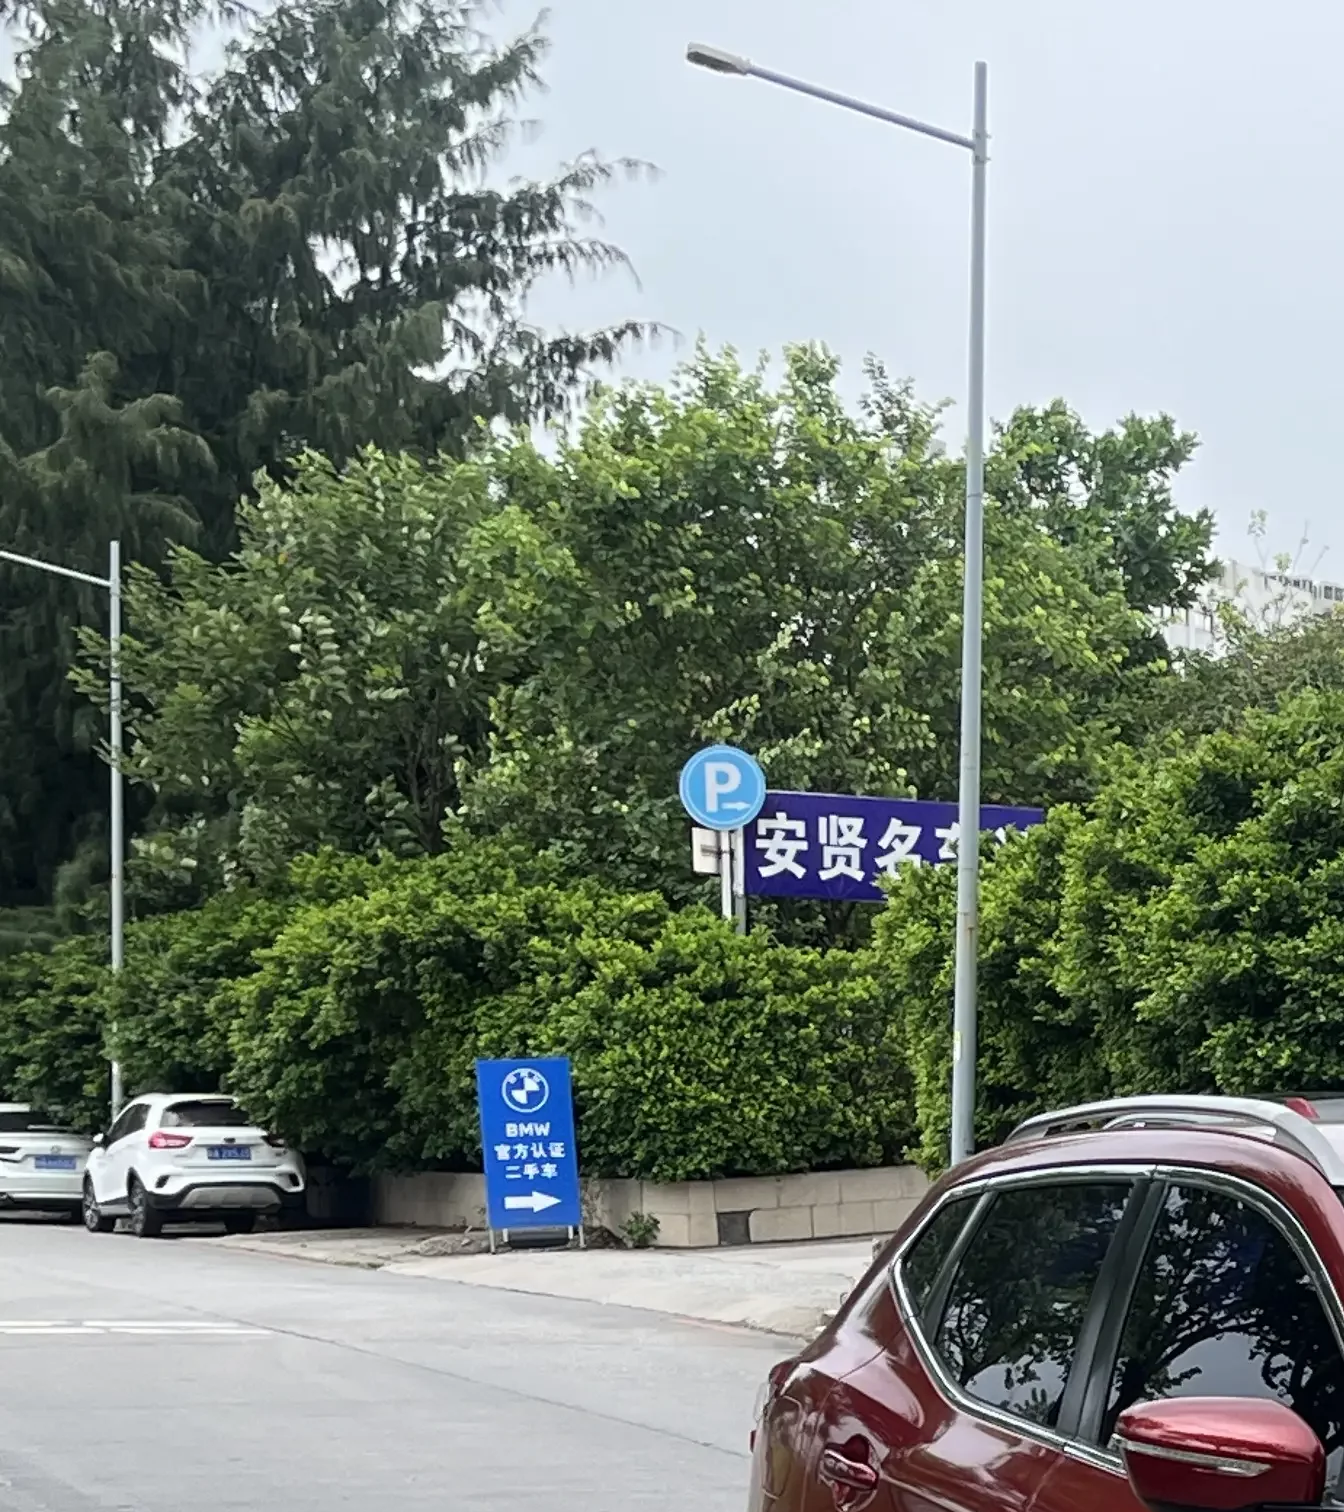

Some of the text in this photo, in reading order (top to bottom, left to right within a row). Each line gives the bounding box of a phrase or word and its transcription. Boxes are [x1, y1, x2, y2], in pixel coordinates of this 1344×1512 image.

[704, 762, 741, 813] P
[754, 811, 1030, 884] 安贤名
[505, 1121, 550, 1138] BMW
[493, 1141, 566, 1161] 官方认证
[505, 1162, 558, 1180] 二手车
